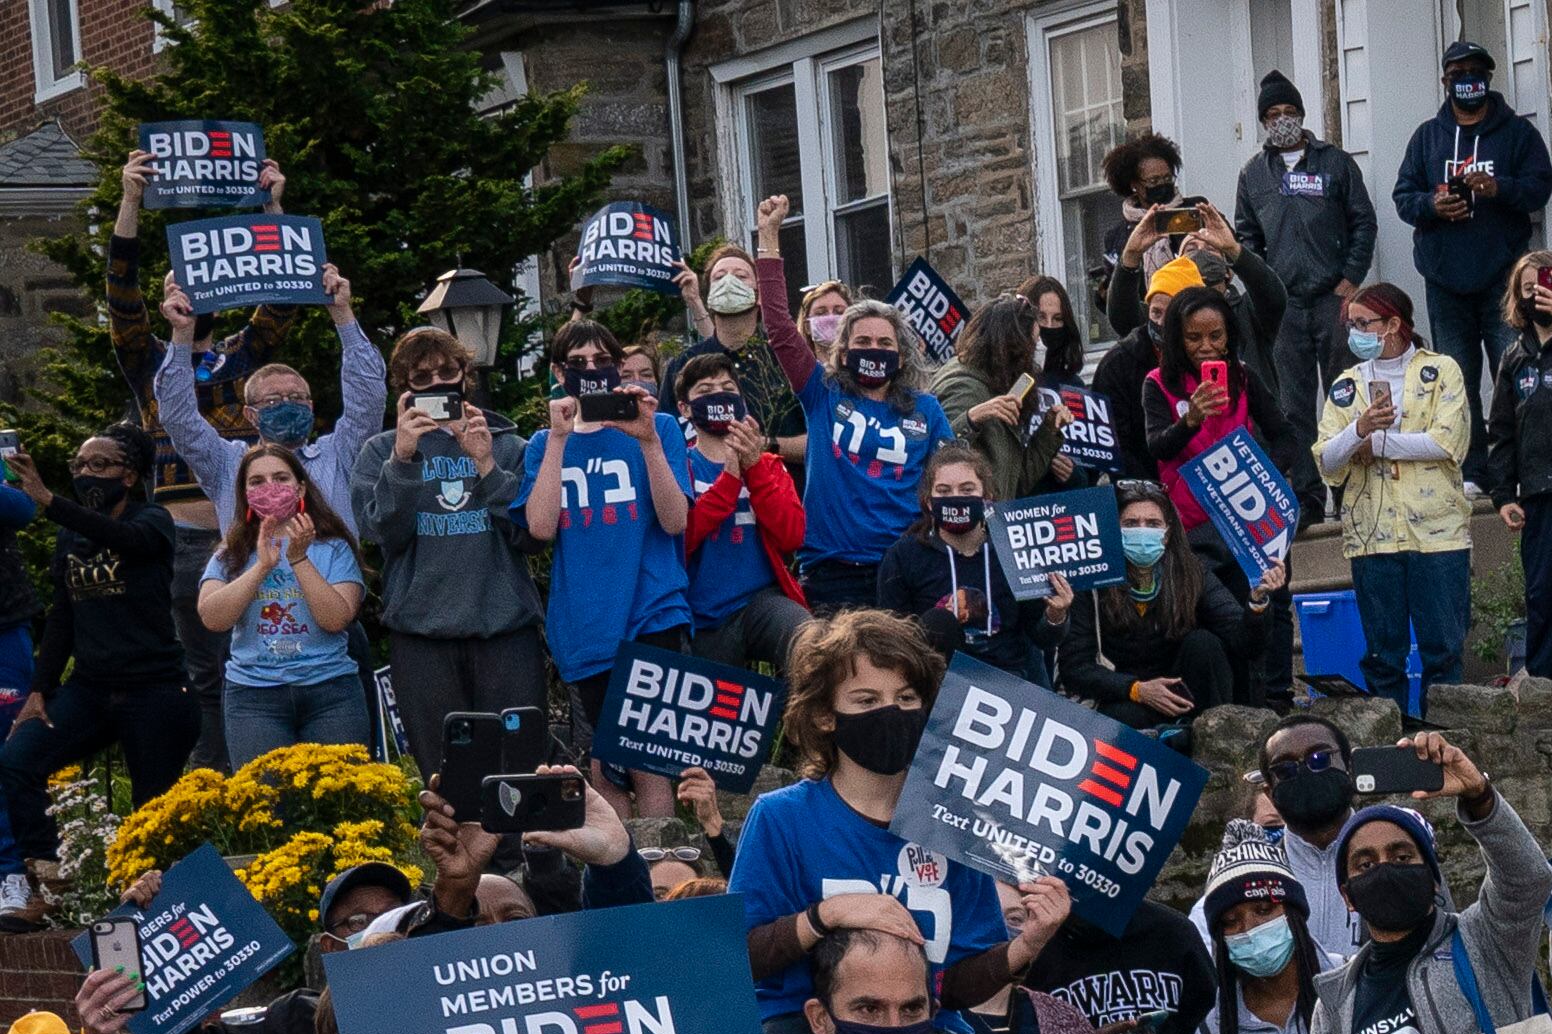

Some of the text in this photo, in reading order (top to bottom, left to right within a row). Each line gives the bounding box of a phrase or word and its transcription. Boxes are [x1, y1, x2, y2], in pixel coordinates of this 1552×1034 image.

[150, 131, 256, 158] BIDEN
[152, 160, 258, 182] HARRIS
[176, 185, 215, 194] UNITED
[225, 187, 255, 195] 30330
[181, 224, 313, 261] BIDEN
[584, 212, 671, 246] BIDEN
[186, 254, 317, 286] HARRIS
[581, 239, 673, 267] HARRIS
[194, 280, 313, 300] Text UNITED to 30330
[599, 264, 636, 273] UNITED
[646, 268, 671, 280] 30330
[895, 292, 955, 364] HARRIS
[1038, 388, 1110, 424] DEN
[1081, 446, 1113, 461] 30330
[1232, 435, 1296, 524] VETERANS for
[1004, 503, 1066, 522] WOMEN for
[1202, 444, 1288, 561] BIDEN
[1007, 513, 1099, 549] BIDEN
[1206, 483, 1245, 536] VETERANS
[1248, 546, 1268, 570] 3033
[1013, 539, 1103, 570] HARRIS
[1078, 563, 1109, 576] 30330
[282, 623, 310, 635] SEA
[626, 658, 773, 727] BIDEN
[618, 698, 762, 758] HARRIS
[618, 736, 746, 776] Text UNITED to 30330
[952, 685, 1182, 831] BIDEN
[934, 744, 1155, 875] HARRIS
[931, 803, 1121, 898] Text UNITED to 30330
[172, 902, 185, 919] for
[143, 903, 220, 976] BIDEN
[147, 927, 235, 1000] HARRIS
[433, 950, 537, 985] UNION
[153, 1007, 174, 1026] Text
[174, 975, 215, 1011] POWER
[215, 969, 226, 980] to
[226, 941, 261, 972] 30330
[440, 971, 630, 1017] MEMBERS for
